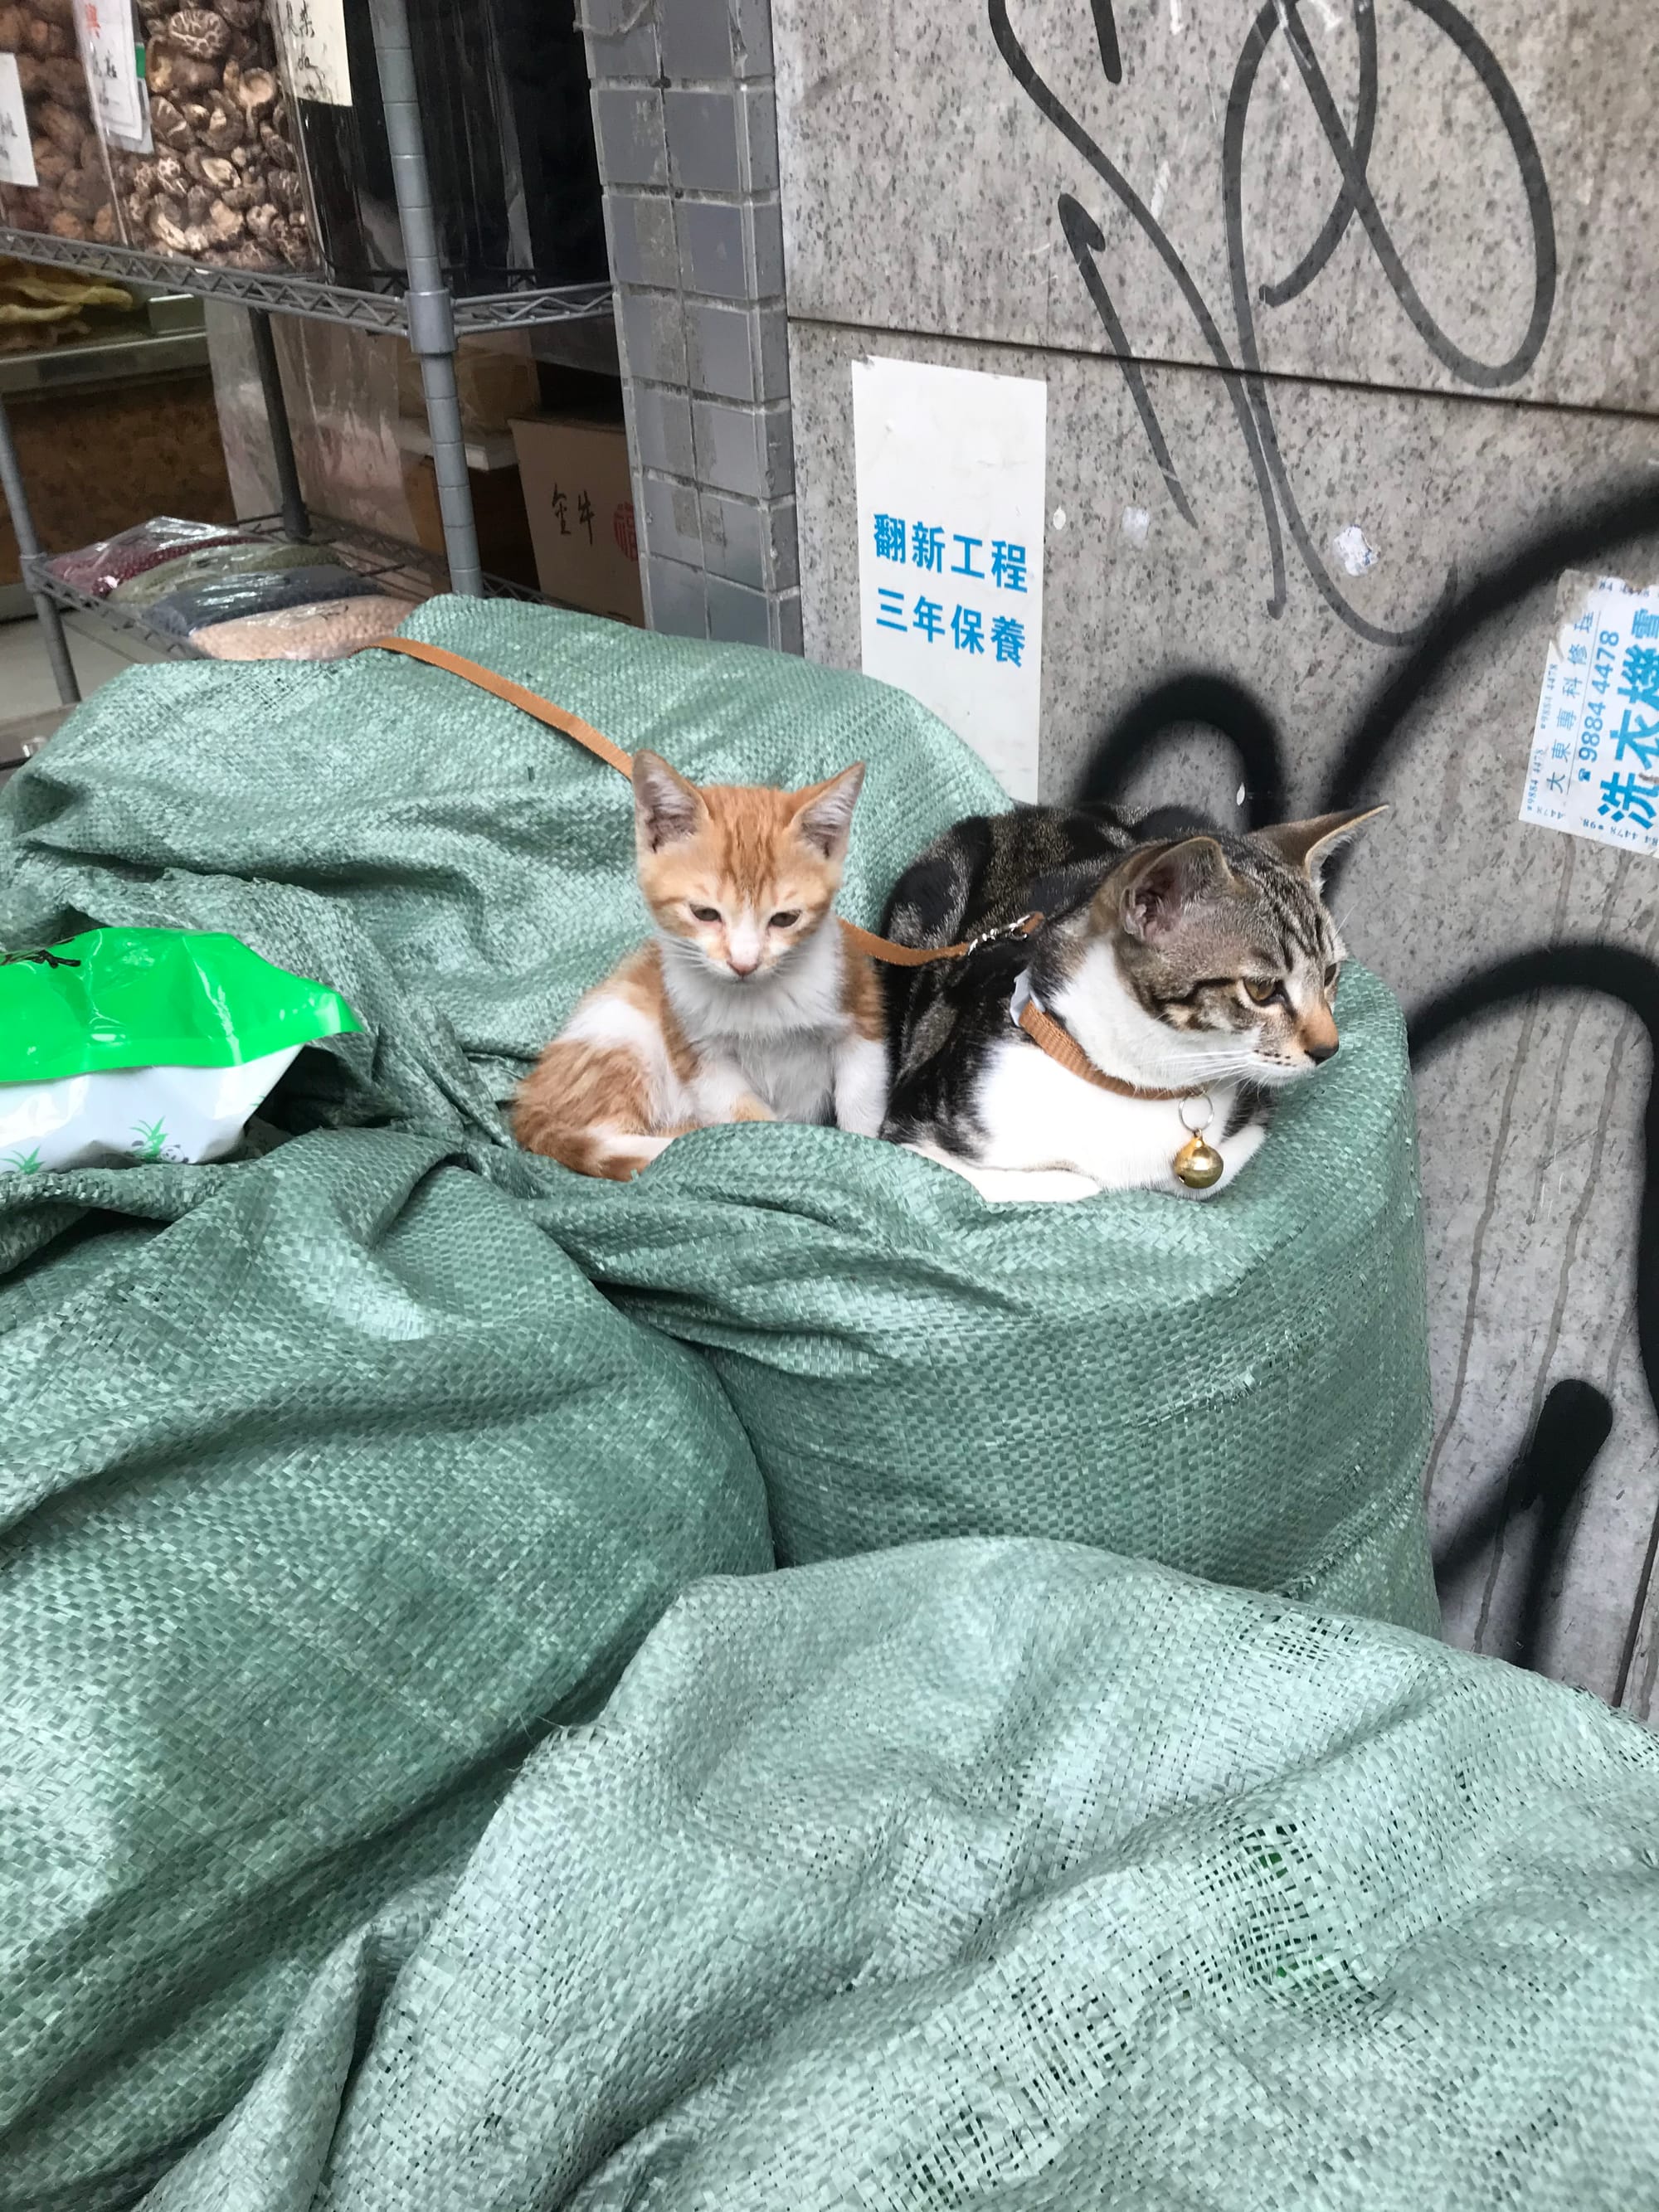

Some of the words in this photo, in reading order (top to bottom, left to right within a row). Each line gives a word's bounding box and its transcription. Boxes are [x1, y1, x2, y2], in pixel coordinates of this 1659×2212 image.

[873, 513, 1028, 594] 翻新工程
[876, 586, 1026, 668] 三年保養
[1591, 630, 1619, 695] 4478
[1578, 701, 1606, 763] 9884
